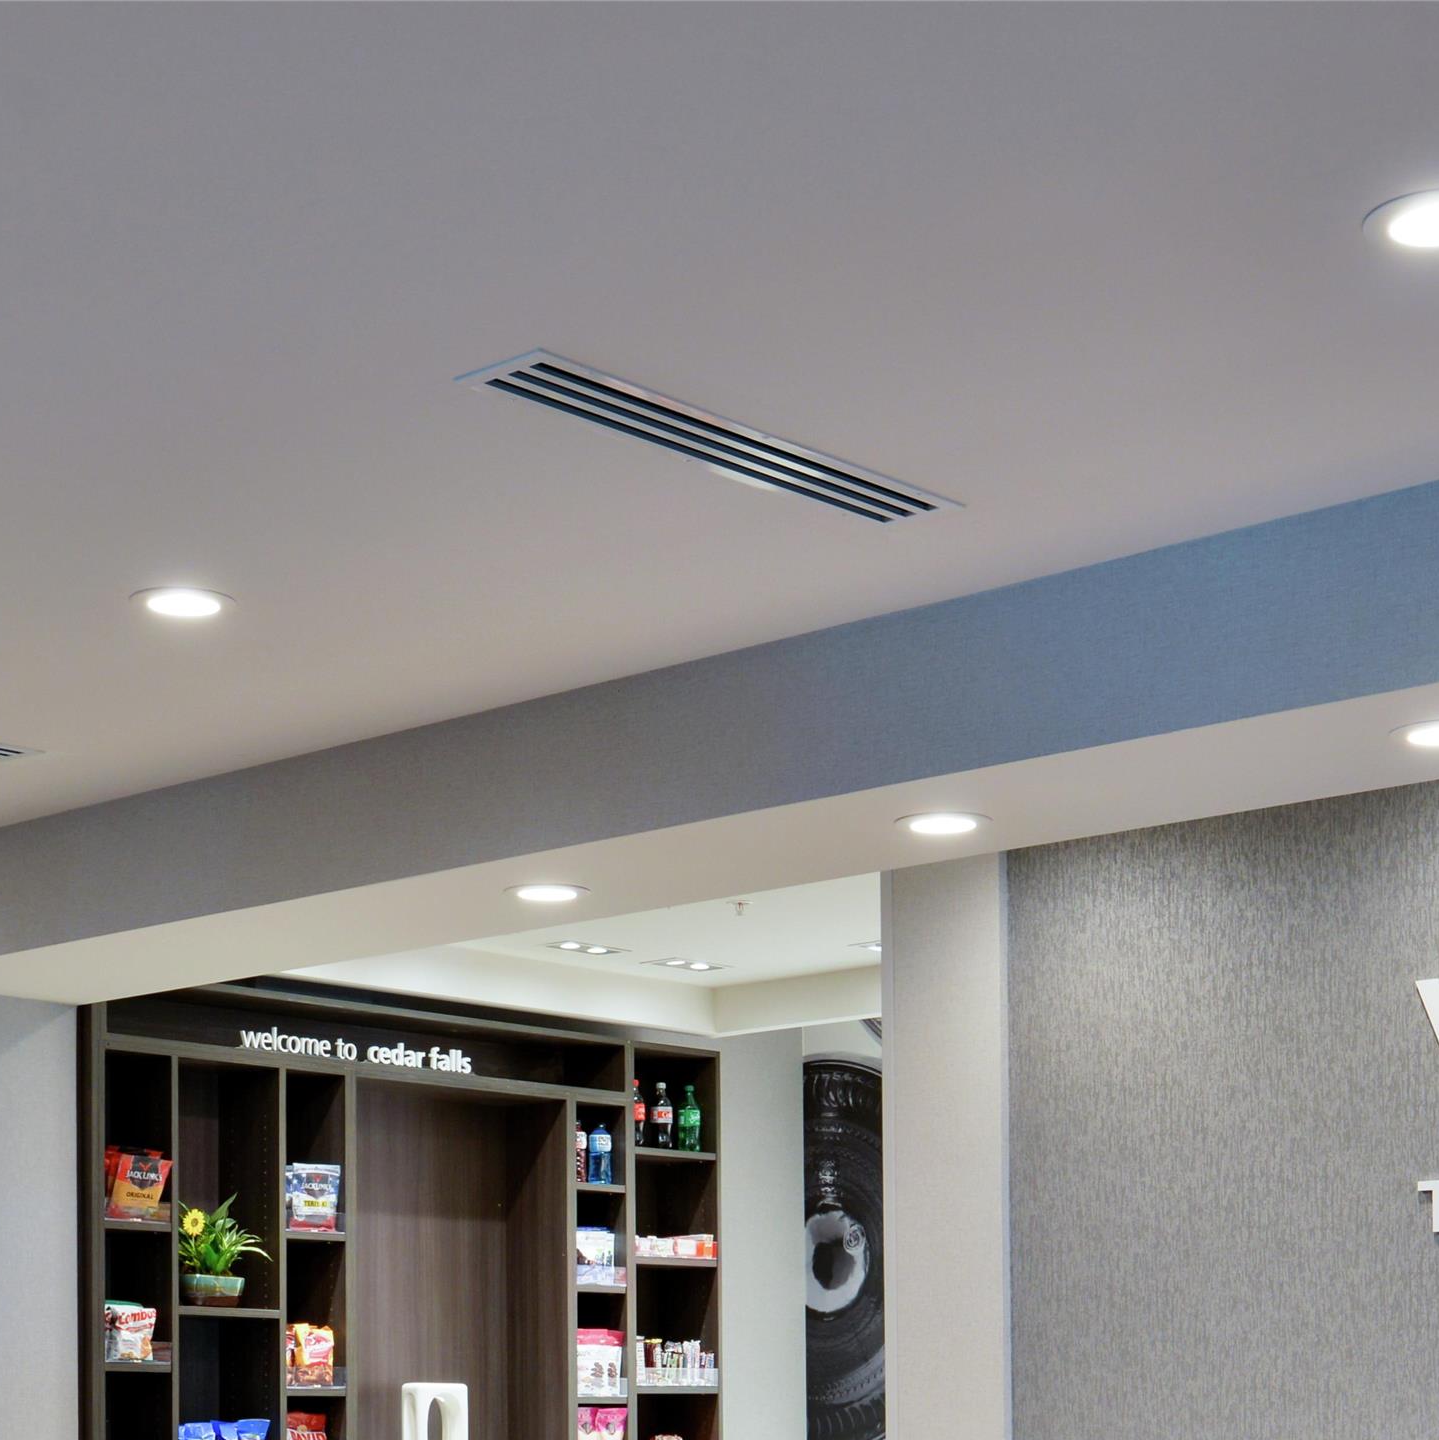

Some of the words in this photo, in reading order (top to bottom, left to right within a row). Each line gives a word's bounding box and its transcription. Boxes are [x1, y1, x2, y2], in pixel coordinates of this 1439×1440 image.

[240, 1027, 331, 1058] welcome
[335, 1037, 358, 1062] to
[367, 1042, 426, 1069] cedar
[427, 1046, 472, 1075] falls
[126, 1191, 154, 1200] ORIGINAL
